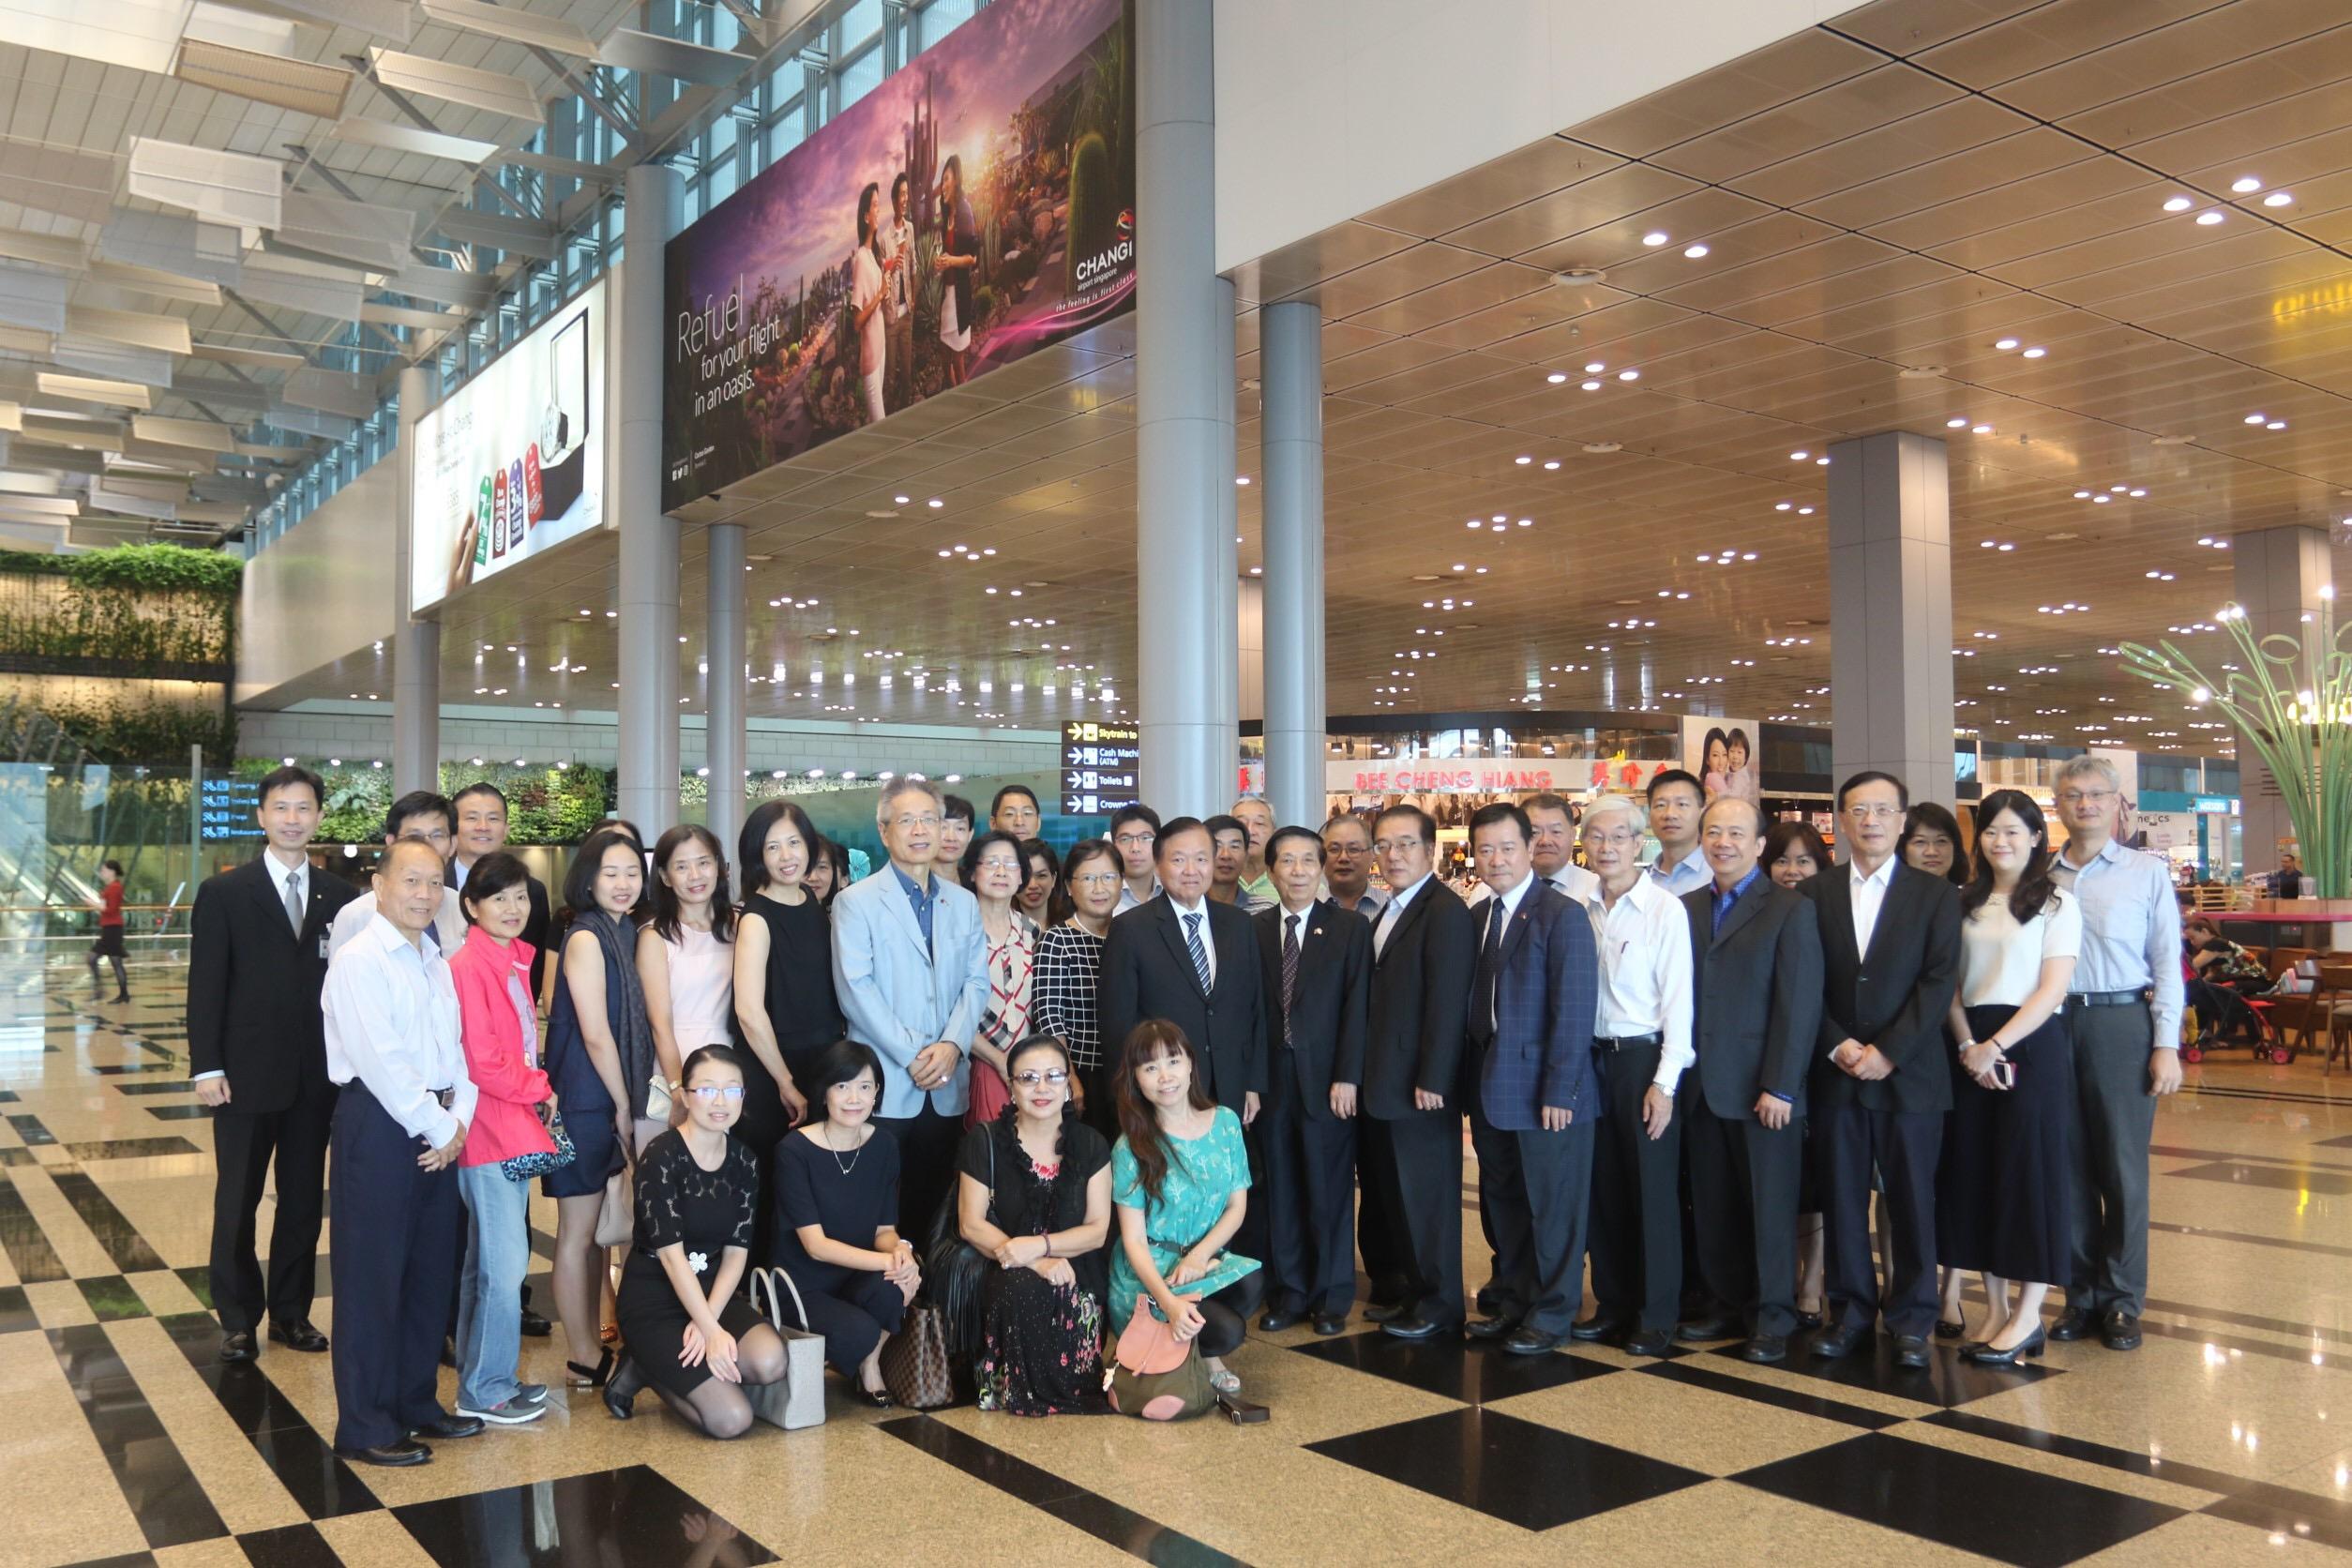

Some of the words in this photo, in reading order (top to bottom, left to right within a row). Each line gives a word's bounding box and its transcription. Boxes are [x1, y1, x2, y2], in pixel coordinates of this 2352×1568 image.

[1076, 240, 1133, 280] CHANGI
[1056, 301, 1066, 312] the
[1067, 294, 1091, 309] feeling
[1092, 291, 1098, 301] is
[1100, 282, 1116, 296] first
[1116, 272, 1134, 289] class
[1077, 276, 1093, 292] airport
[1093, 267, 1118, 285] singapore
[677, 272, 744, 363] Refuel
[701, 352, 717, 381] for
[719, 337, 747, 377] your
[748, 317, 780, 355] flight
[694, 390, 706, 417] in
[707, 385, 721, 411] an
[723, 365, 755, 402] oasis.
[1098, 729, 1128, 740] Skytrain
[1129, 731, 1138, 740] to
[1099, 747, 1116, 758] Cash
[1099, 758, 1119, 766] (ATM)
[1099, 776, 1123, 786] Toilets
[1354, 771, 1389, 790] BEE
[1395, 770, 1474, 790] CHENG
[1481, 770, 1553, 789] HIANG
